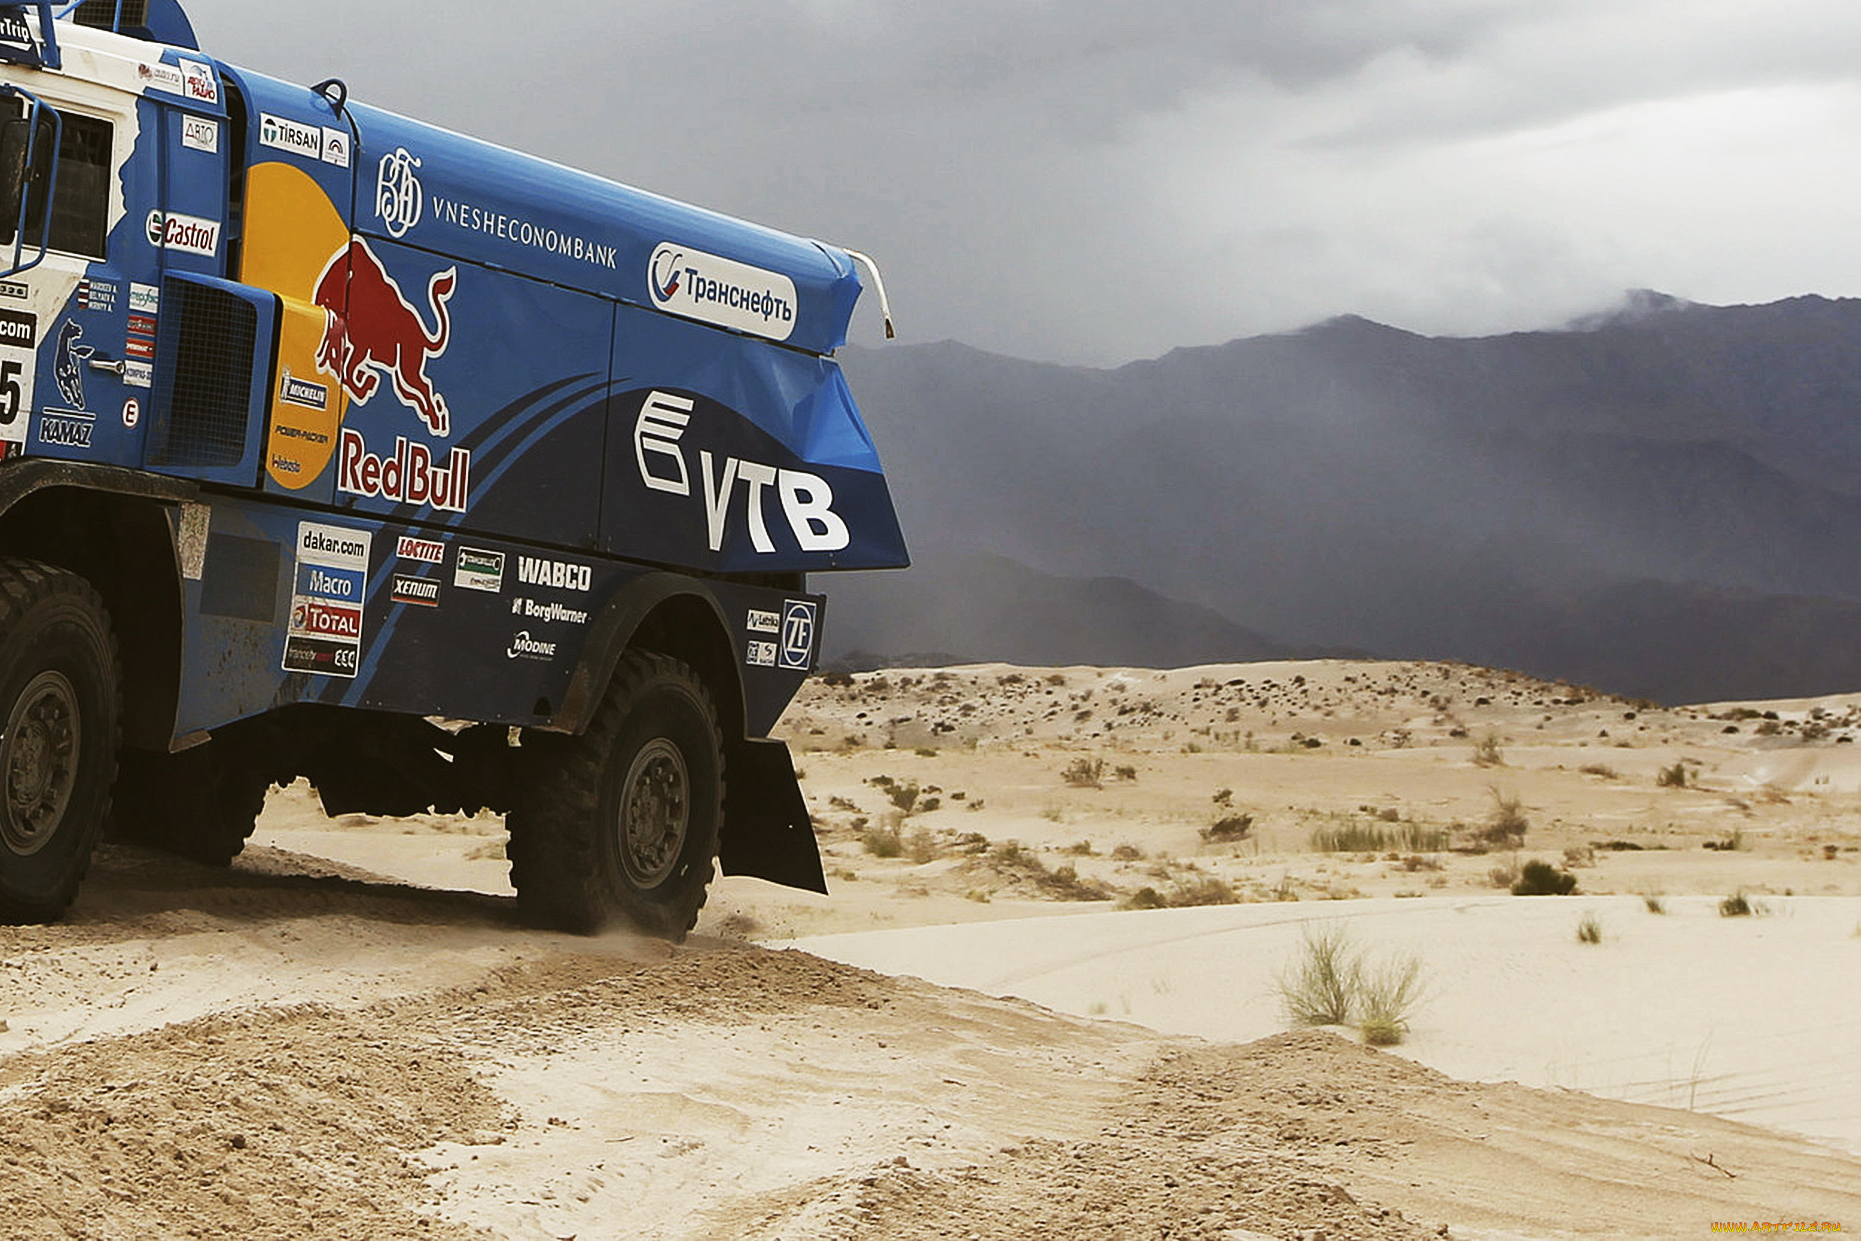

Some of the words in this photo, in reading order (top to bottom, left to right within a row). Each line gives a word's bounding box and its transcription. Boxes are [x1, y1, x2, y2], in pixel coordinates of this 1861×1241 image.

[164, 218, 215, 251] Castrol
[432, 196, 617, 270] VNESHECONOMBANK
[685, 267, 792, 322] Транснефть
[289, 383, 325, 403] MICHELIN
[39, 418, 93, 447] KAMAZ
[338, 428, 407, 502] Red
[406, 442, 470, 512] Bull
[700, 450, 850, 552] VTB
[303, 531, 364, 557] dakar.com
[398, 538, 443, 561] LOCTITE
[309, 570, 351, 596] Macro
[518, 556, 591, 592] WABCO
[310, 608, 357, 634] TOTAL
[525, 599, 587, 624] BorgWarner
[513, 639, 556, 655] MODINE
[787, 617, 811, 652] ZF
